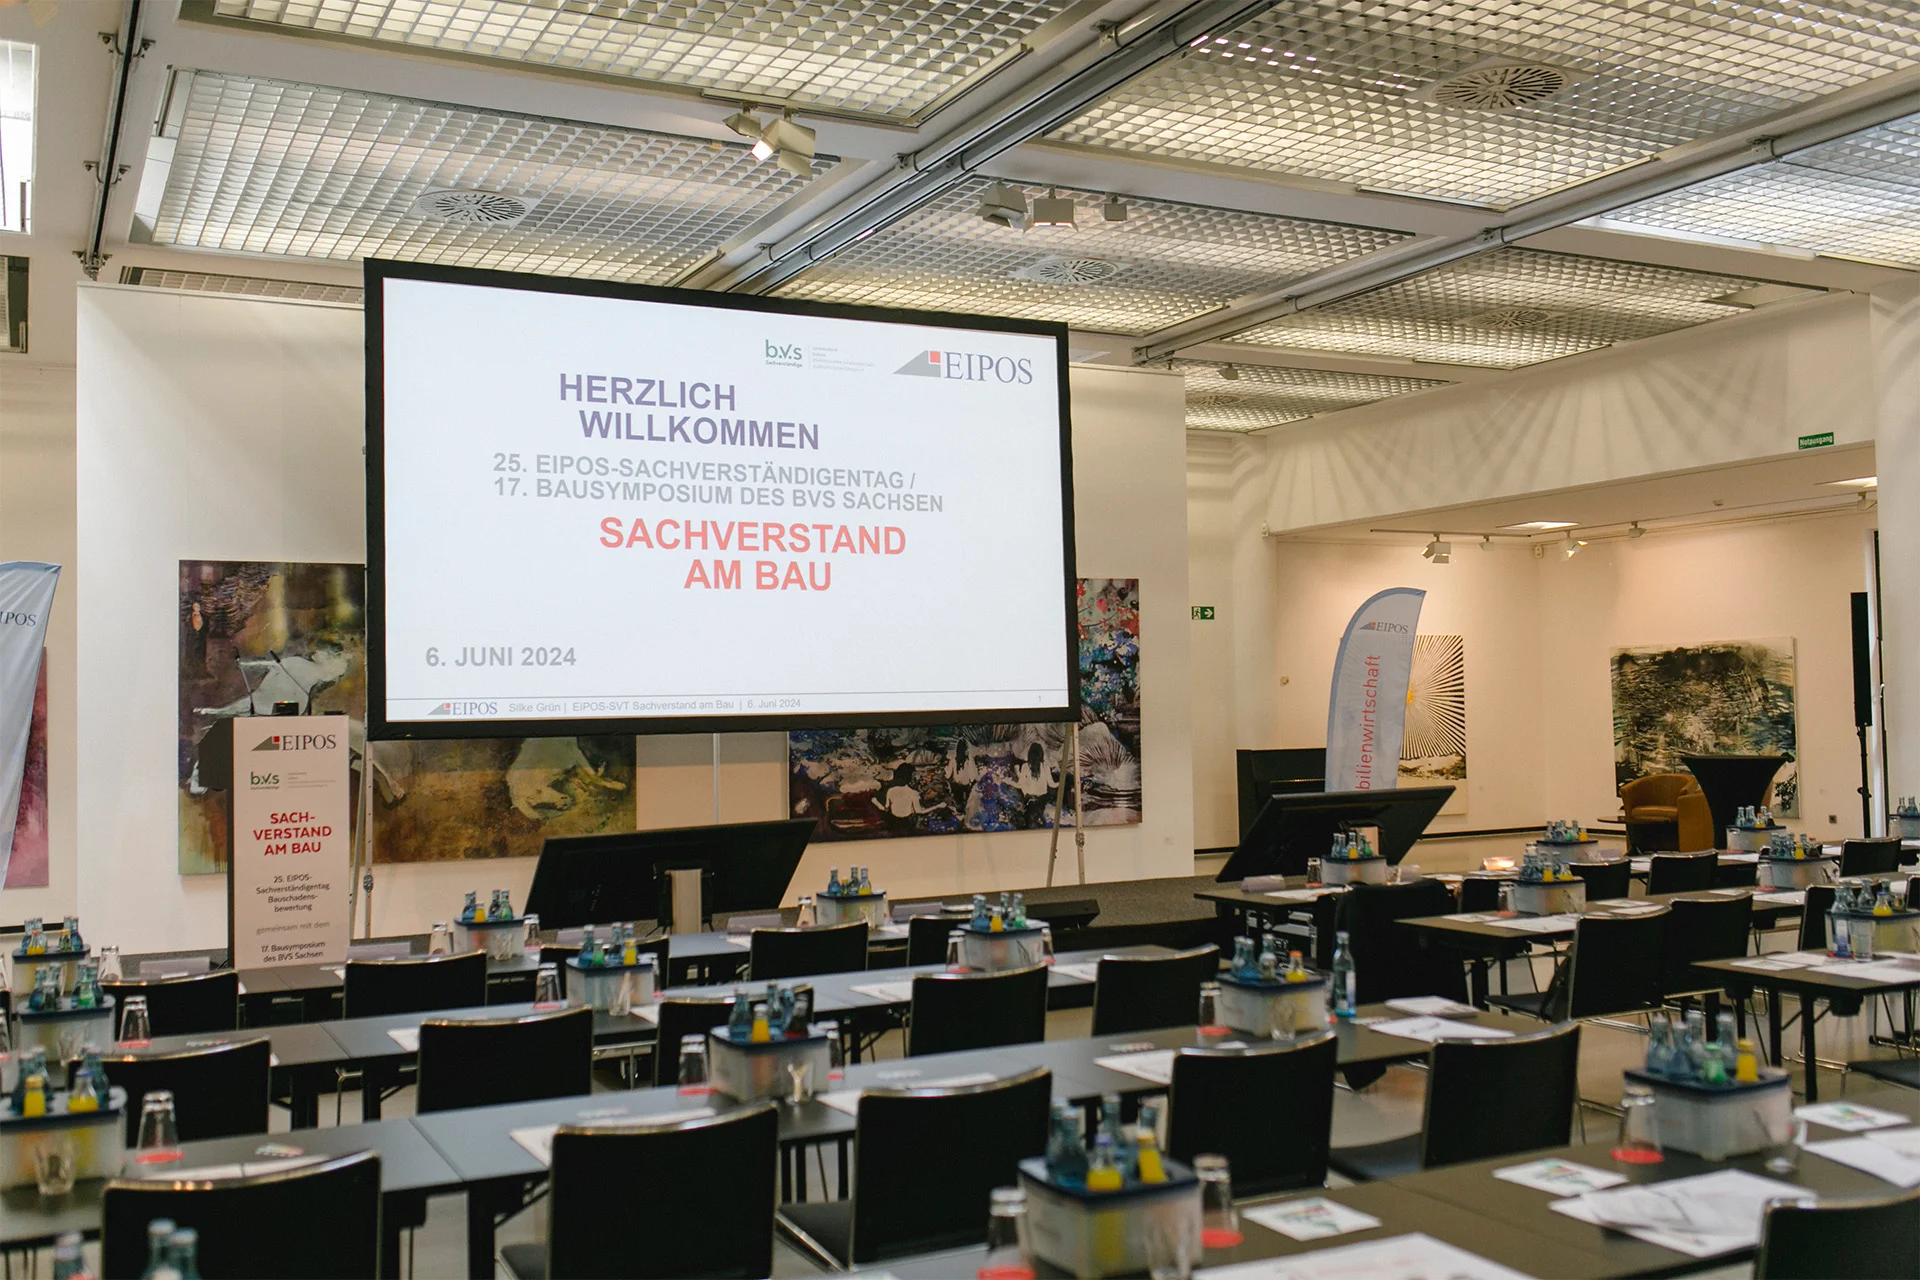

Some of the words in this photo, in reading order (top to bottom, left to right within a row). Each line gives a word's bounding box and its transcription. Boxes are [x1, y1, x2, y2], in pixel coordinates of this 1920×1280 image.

[943, 350, 1033, 386] EIPOS
[560, 373, 735, 411] HERZLICH
[579, 410, 818, 450] WILLKOMMEN
[1799, 436, 1833, 446] Notausgang
[493, 453, 528, 475] 25.
[536, 454, 905, 489] EIPOS-SACHVERSTÄNDIGENTAG
[494, 477, 528, 497] 17.
[536, 479, 732, 505] BAUSYMPOSIUM
[740, 487, 784, 507] DES
[792, 489, 836, 509] BVS
[842, 492, 943, 512] SACHSEN
[599, 517, 906, 555] SACHVERSTAND
[683, 559, 741, 589] AM
[755, 560, 831, 591] BAU
[1376, 622, 1408, 634] EIPOS
[425, 647, 446, 667] 6.
[454, 646, 513, 667] JUNI
[521, 646, 577, 667] 2024
[452, 702, 498, 716] EIPOS
[509, 702, 533, 712] Silke
[535, 701, 561, 713] Grün
[572, 701, 629, 712] EIPOS-SVT
[632, 699, 697, 711] Sachverstand
[699, 702, 714, 710] am
[716, 699, 734, 709] Bau
[747, 700, 756, 709] 6.
[758, 699, 777, 709] Juni
[779, 698, 801, 708] 2024
[282, 734, 336, 751] EIPOS
[270, 811, 316, 824] SACH-
[253, 826, 333, 841] VERSTAND
[264, 842, 287, 856] AM
[291, 841, 322, 854] BAU
[273, 875, 285, 884] 25.
[286, 873, 312, 883] EIPOS-
[256, 882, 330, 895] Sachverständigentag
[268, 893, 318, 904] Bauschadens-
[274, 903, 313, 913] bewertung
[256, 924, 298, 936] gemeinsam
[300, 922, 314, 930] mit
[315, 921, 330, 929] dem
[271, 940, 326, 954] Bausymposium
[263, 954, 276, 963] des
[278, 953, 293, 962] BVS
[294, 950, 324, 961] Sachsen
